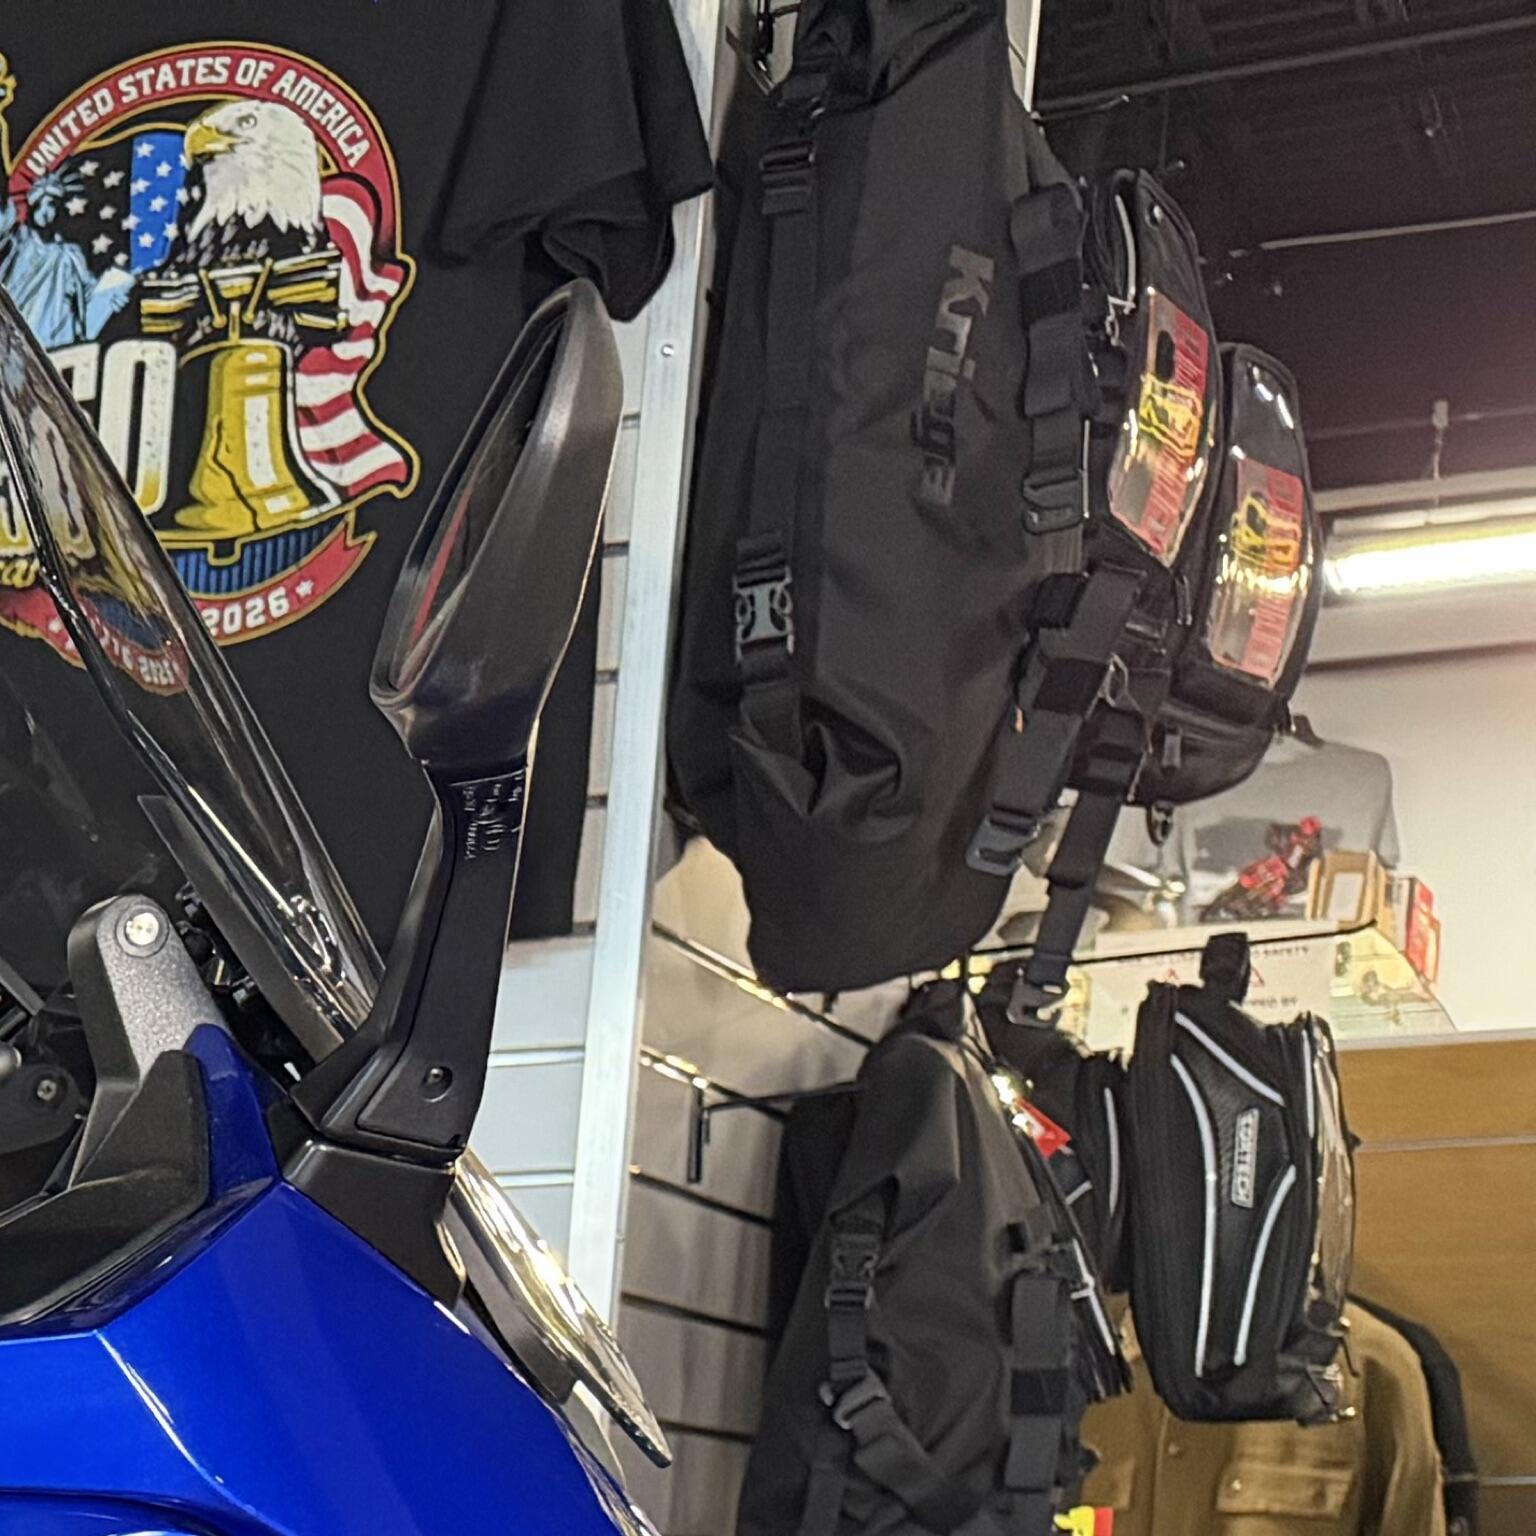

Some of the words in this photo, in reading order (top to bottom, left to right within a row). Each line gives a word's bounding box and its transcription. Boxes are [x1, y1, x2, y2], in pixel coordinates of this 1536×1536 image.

[25, 90, 115, 176] UNITED
[117, 56, 231, 104] STATES
[234, 57, 276, 87] OF
[271, 69, 373, 168] AMERICA
[912, 245, 994, 507] Kriega
